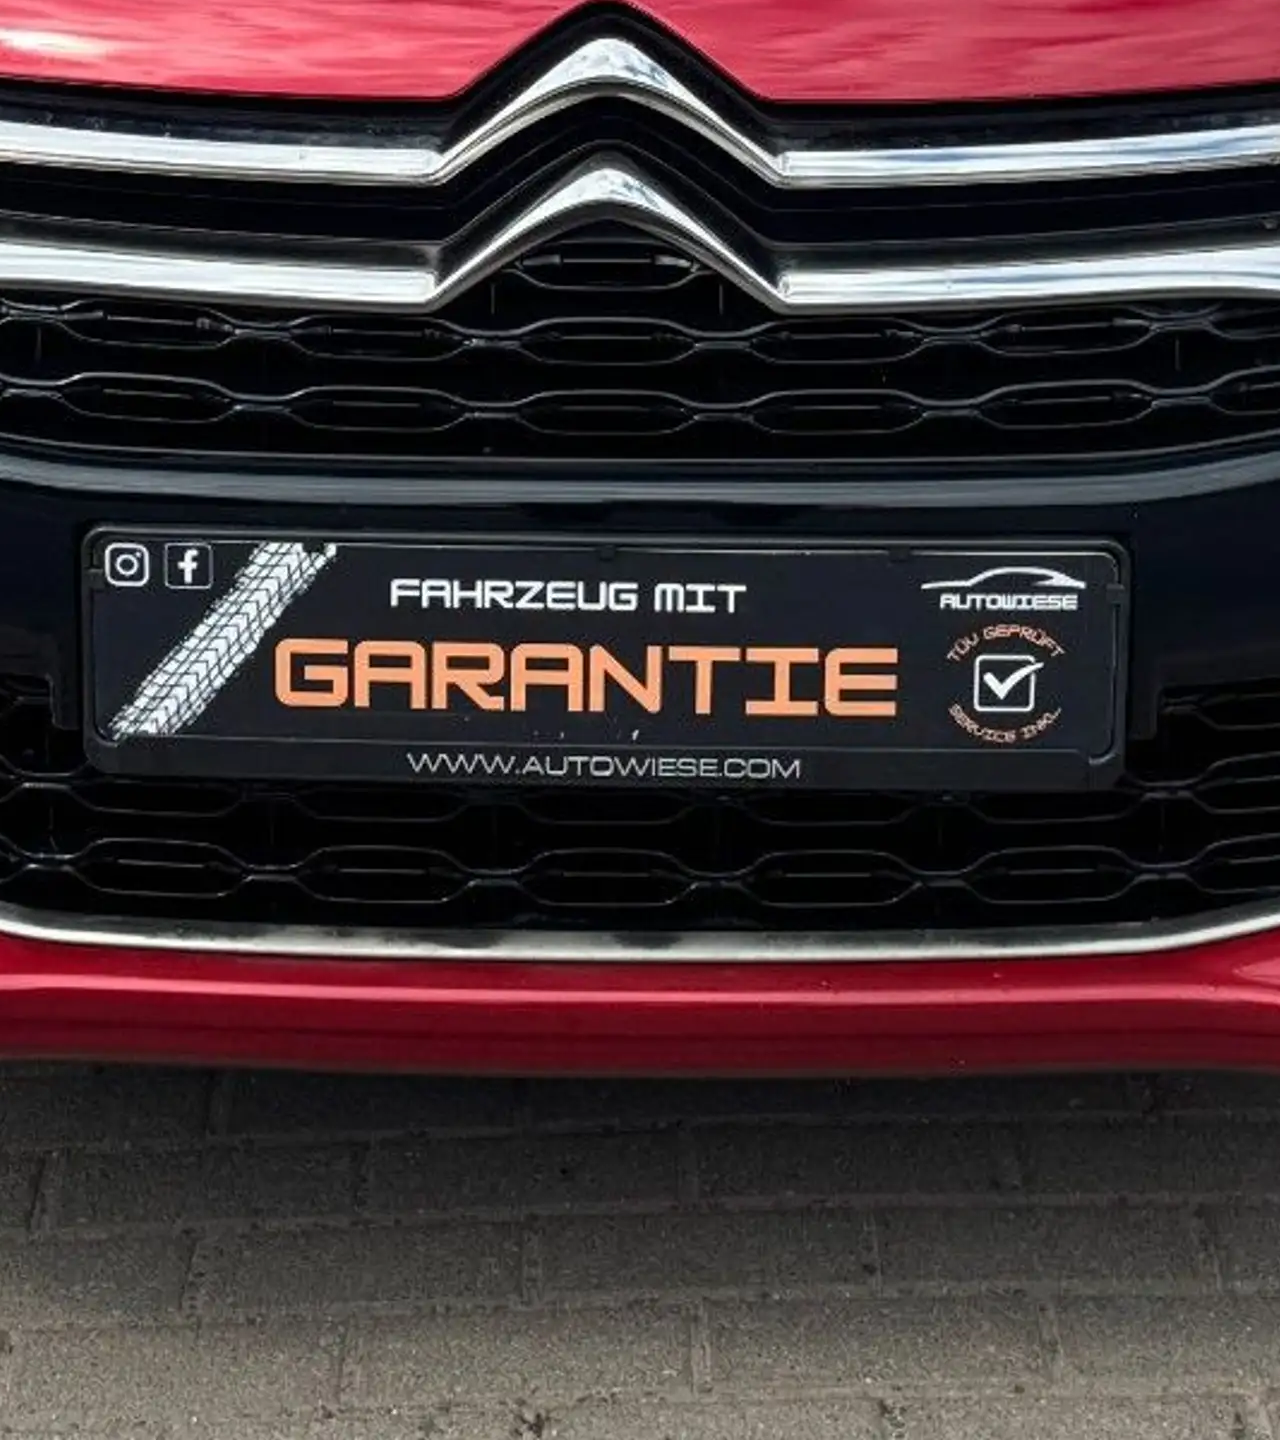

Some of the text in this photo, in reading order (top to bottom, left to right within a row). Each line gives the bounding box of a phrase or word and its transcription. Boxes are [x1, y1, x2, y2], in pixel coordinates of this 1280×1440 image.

[390, 578, 747, 613] FAHRZEUG MIT
[939, 593, 1078, 611] AUTOWIESE
[982, 624, 1066, 658] GEPRÜFT
[275, 638, 898, 717] GARANTIE
[947, 703, 1017, 743] SERVICE
[406, 752, 802, 780] WWW.AUTOWIESE.COM
